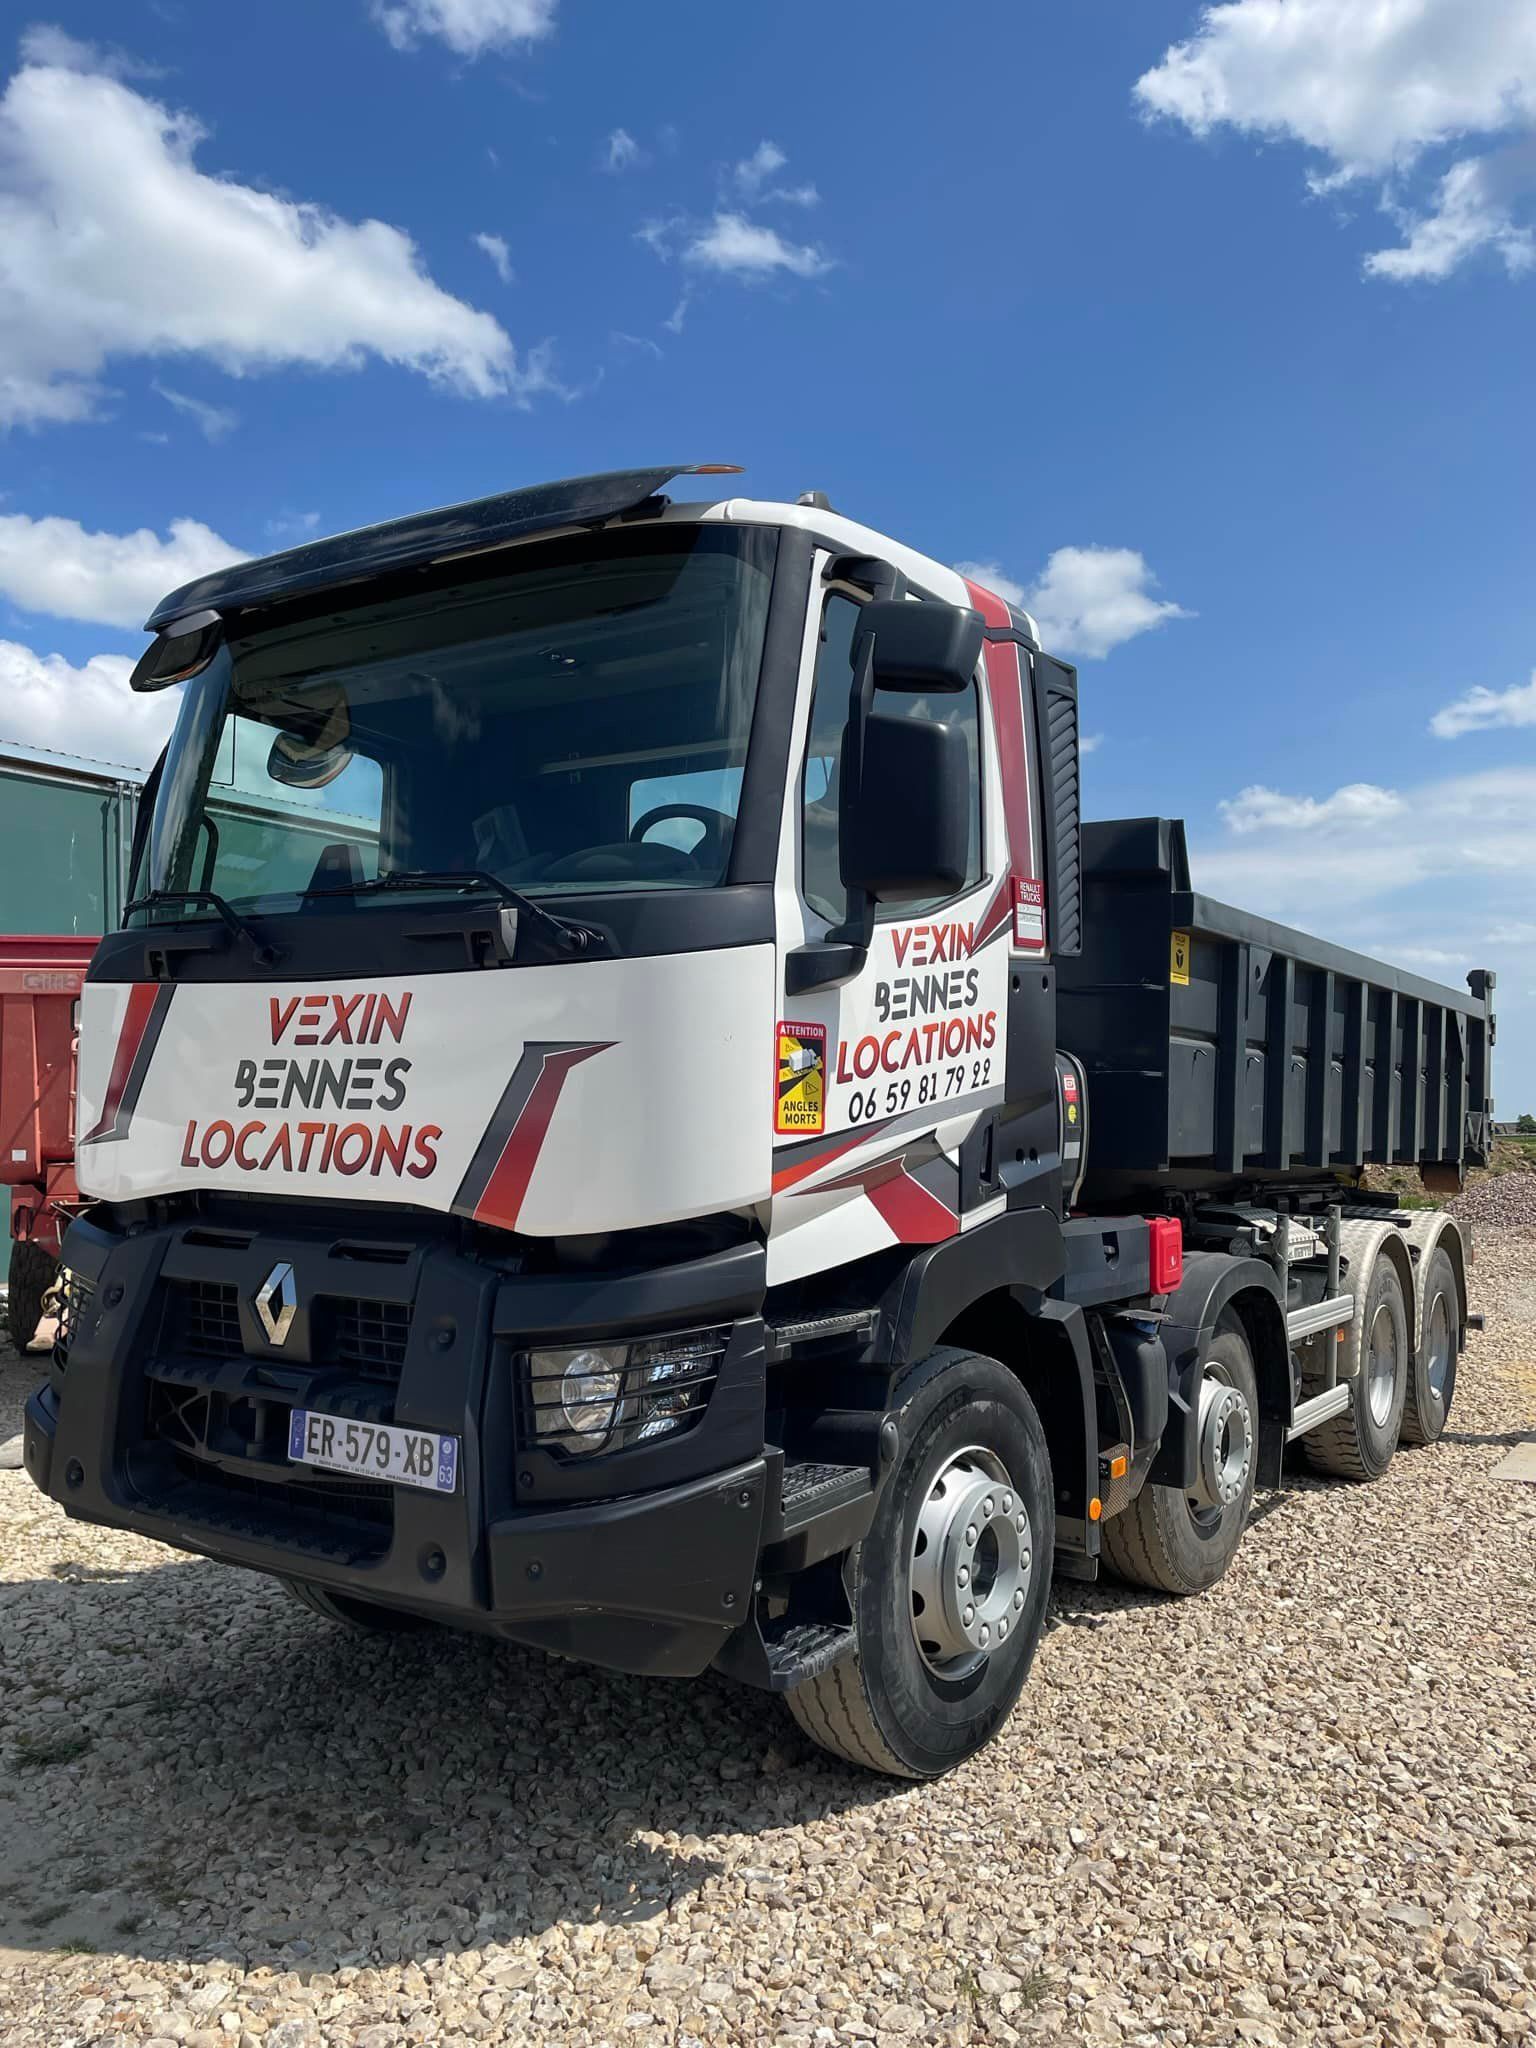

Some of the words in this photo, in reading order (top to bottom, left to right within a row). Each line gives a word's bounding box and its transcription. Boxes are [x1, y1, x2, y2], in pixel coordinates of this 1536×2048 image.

[1019, 881, 1041, 895] RENAULT
[1020, 890, 1041, 903] TRUCKS
[892, 922, 974, 968] VEXIN
[270, 992, 413, 1046] VEXIN
[875, 968, 979, 1022] BENNES
[780, 1025, 824, 1037] ATTENTION
[836, 1011, 997, 1084] LOCATIONS
[234, 1057, 413, 1111] BENNES
[783, 1101, 819, 1112] ANGLES
[849, 1088, 877, 1123] 06
[886, 1079, 911, 1113] 59
[918, 1073, 938, 1104] 81
[944, 1065, 965, 1097] 79
[971, 1058, 991, 1089] 22
[785, 1114, 817, 1125] MORTS
[181, 1120, 443, 1179] LOCATIONS
[307, 1416, 434, 1477] ER-579-XB
[438, 1466, 453, 1484] 63
